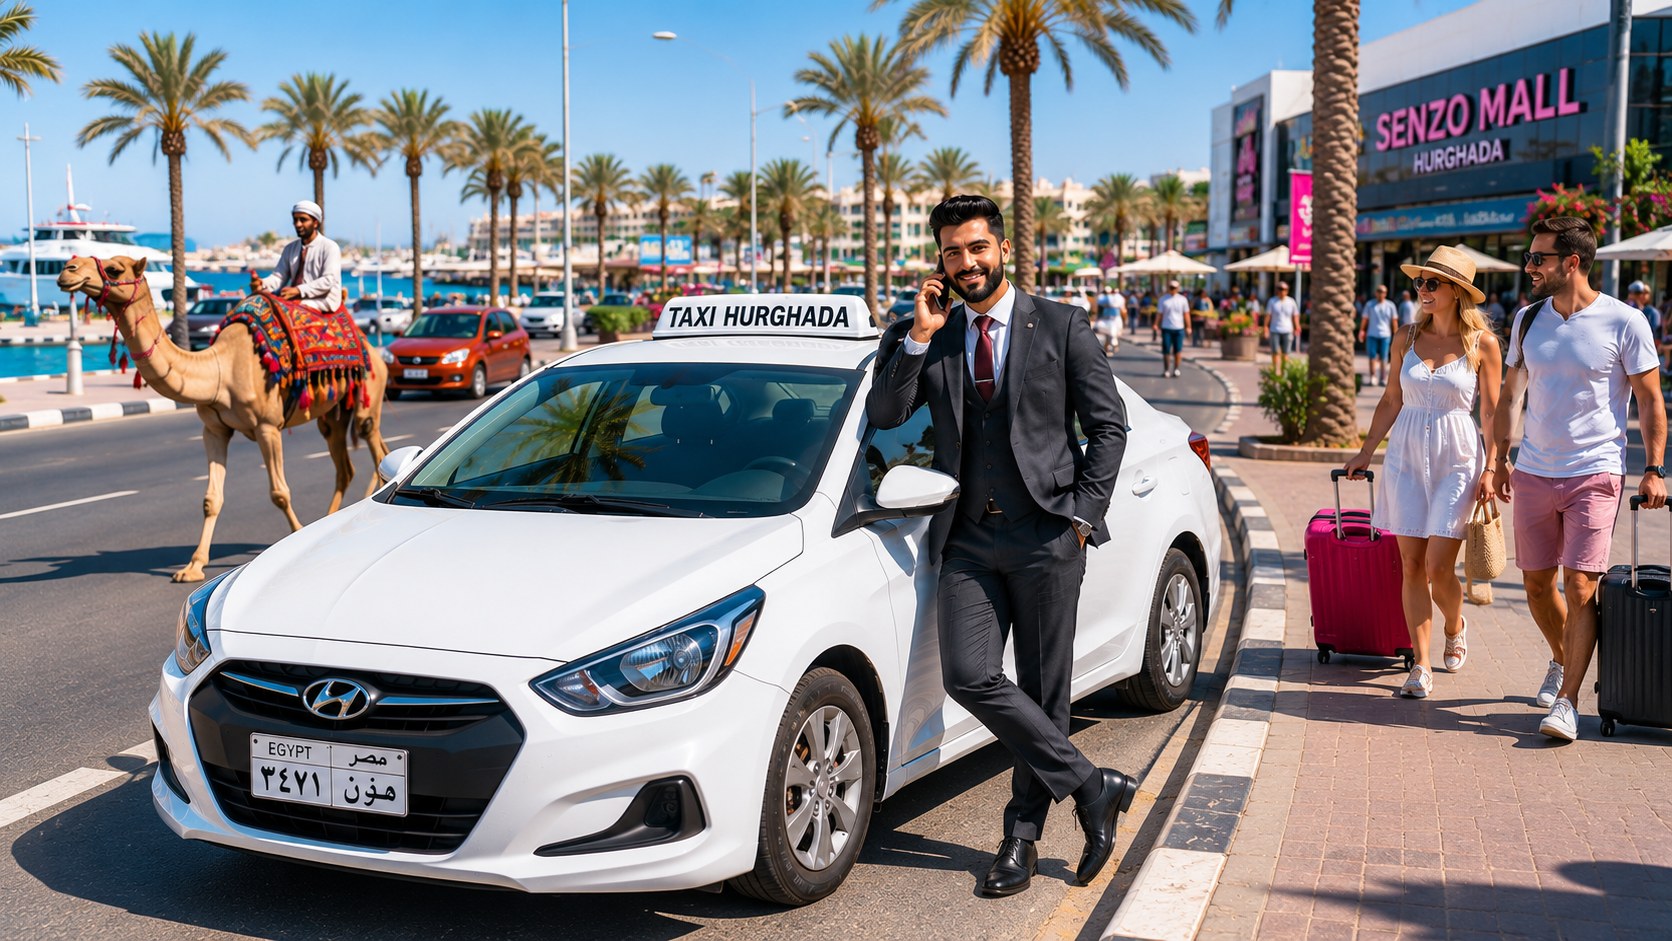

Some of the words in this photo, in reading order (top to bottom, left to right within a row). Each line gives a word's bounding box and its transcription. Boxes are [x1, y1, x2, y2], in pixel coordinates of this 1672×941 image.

[1375, 93, 1470, 151] SENZO
[1479, 67, 1580, 132] MALL
[1413, 138, 1504, 175] HURGHADA
[668, 306, 717, 328] TAXI
[723, 305, 850, 328] HURGHADA
[268, 741, 312, 760] EGYPT
[348, 753, 388, 767] مصر
